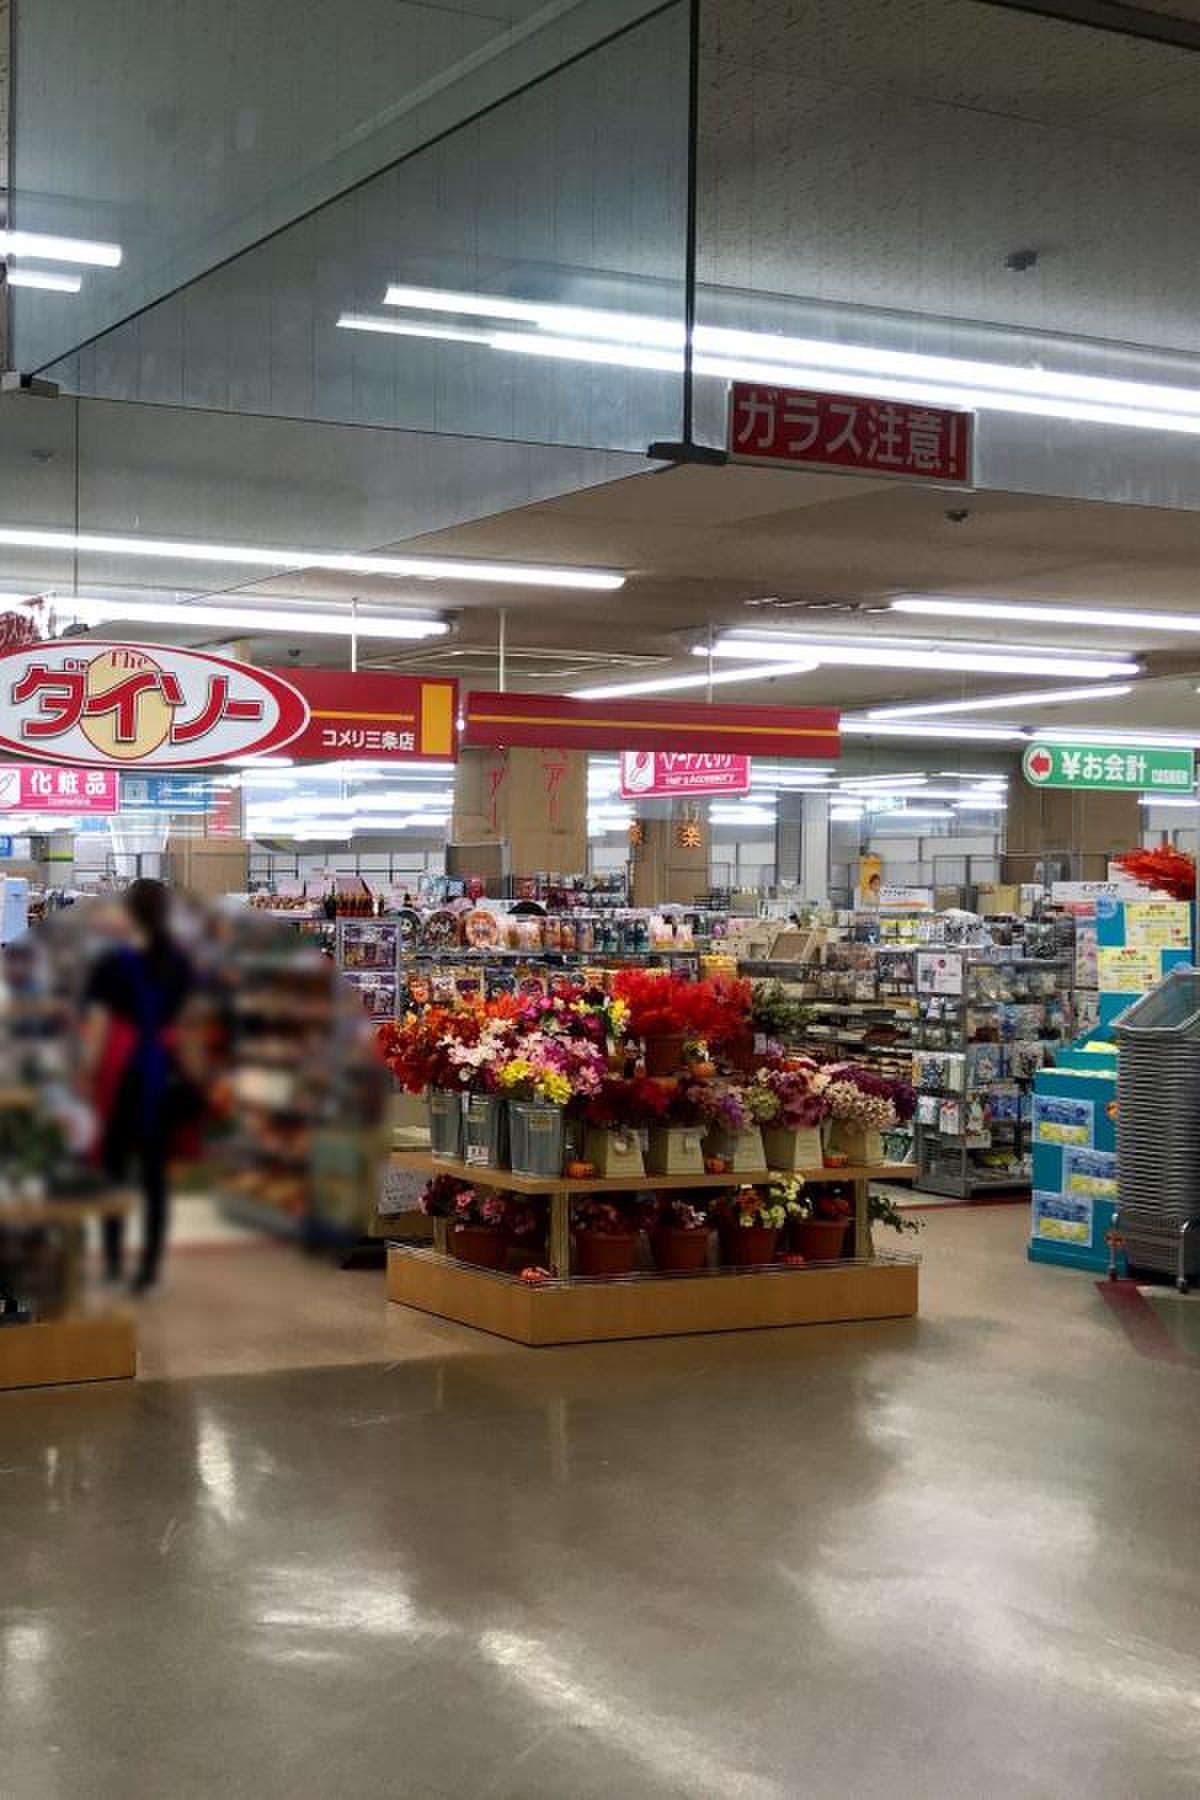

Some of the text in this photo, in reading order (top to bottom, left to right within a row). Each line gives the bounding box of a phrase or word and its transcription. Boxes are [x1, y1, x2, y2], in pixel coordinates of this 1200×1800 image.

[111, 650, 148, 670] The
[11, 658, 264, 745] ダイソー
[322, 729, 415, 752] コメリ三条店
[1061, 751, 1147, 783] ¥お会計
[30, 769, 107, 796] 化粧品
